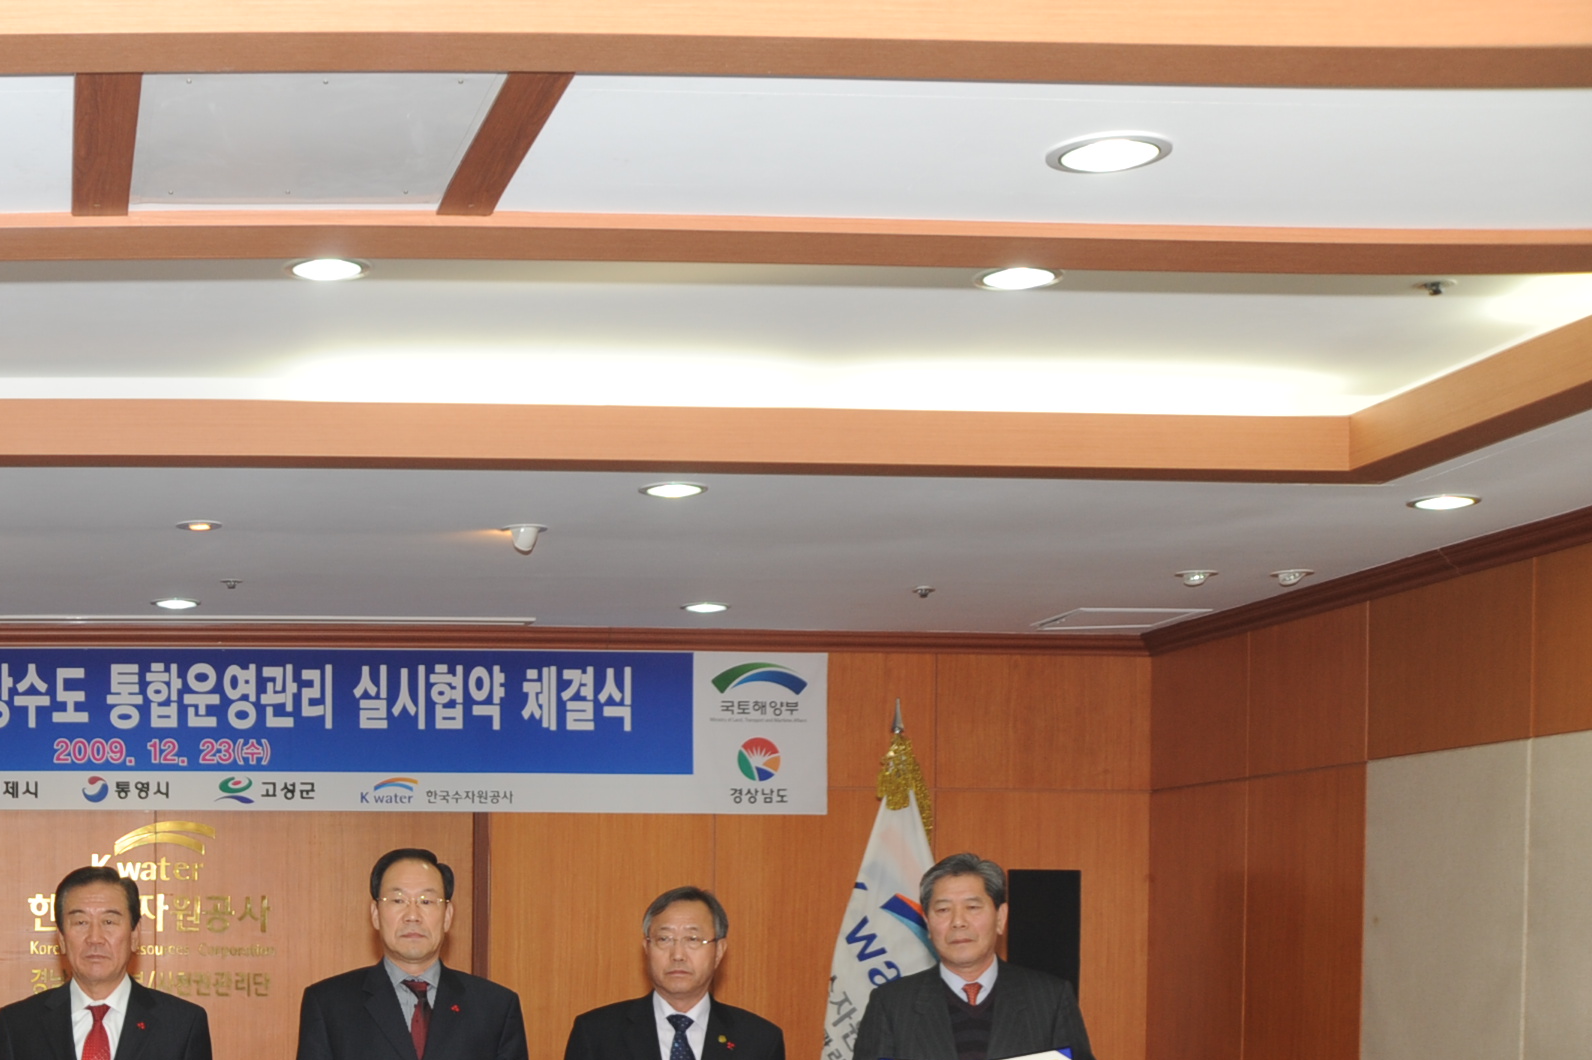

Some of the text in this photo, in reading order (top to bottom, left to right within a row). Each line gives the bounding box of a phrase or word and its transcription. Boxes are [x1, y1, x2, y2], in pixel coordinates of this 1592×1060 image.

[106, 662, 333, 730] 통합운영관리
[352, 664, 506, 730] 실시협약
[521, 665, 632, 732] 체결식
[720, 700, 799, 717] 국토해양부
[53, 738, 271, 766] 2009. 12. 23(수)
[115, 781, 170, 800] 통영시
[261, 781, 316, 800] 고성군
[374, 792, 413, 804] water
[426, 790, 514, 804] 한국수자원공사
[730, 788, 788, 804] 경상남도
[117, 857, 204, 881] water
